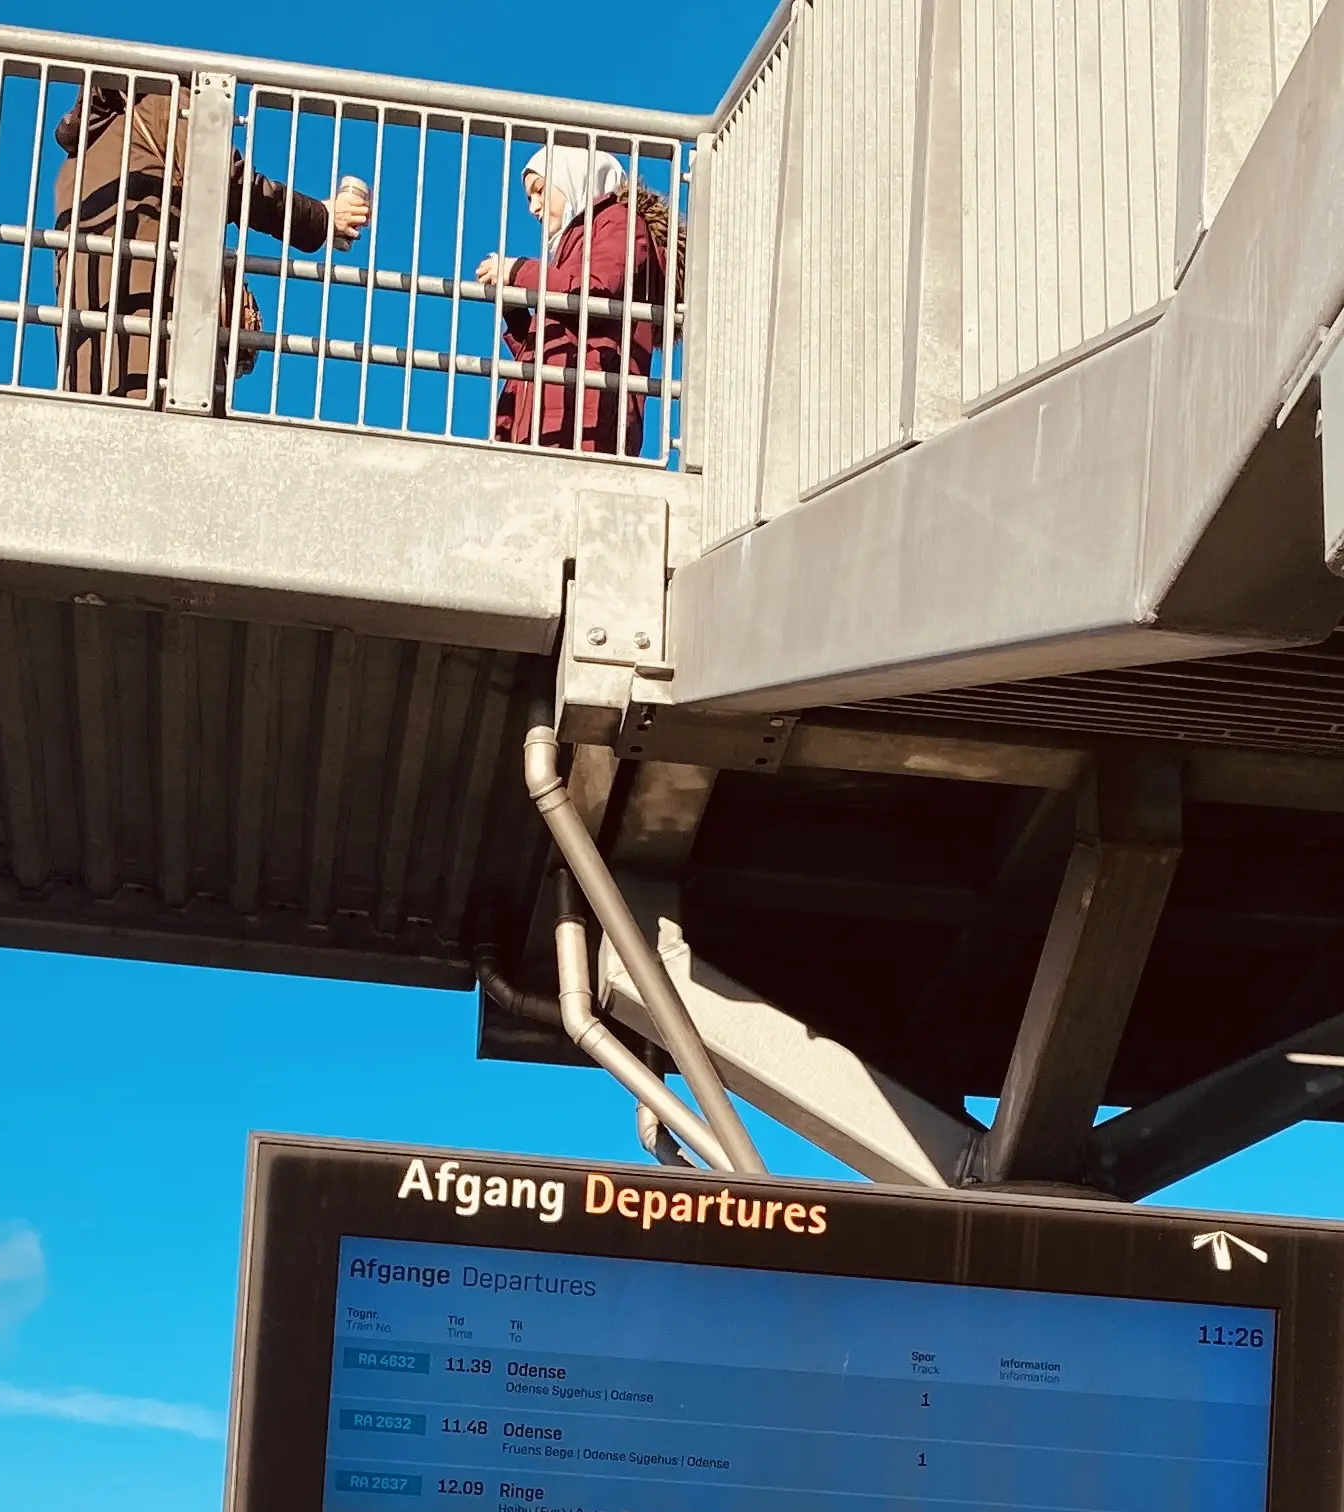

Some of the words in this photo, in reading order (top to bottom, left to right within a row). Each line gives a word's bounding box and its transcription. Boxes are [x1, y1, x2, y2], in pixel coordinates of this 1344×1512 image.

[397, 1159, 564, 1222] Afgang
[585, 1174, 826, 1234] Departures
[349, 1255, 450, 1288] Afgange
[462, 1266, 597, 1296] Departures
[345, 1320, 373, 1331] Train
[447, 1314, 464, 1326] Tid
[509, 1319, 523, 1330] Til
[447, 1327, 472, 1339] Time
[508, 1332, 522, 1343] To
[1197, 1324, 1264, 1349] 11:26
[358, 1353, 377, 1365] RA
[379, 1354, 415, 1368] 4632
[911, 1351, 936, 1363] Spor
[1000, 1357, 1060, 1371] Information
[444, 1356, 492, 1375] 11.39
[506, 1361, 566, 1380] Odense
[910, 1363, 940, 1375] Track
[999, 1370, 1060, 1384] Information
[505, 1382, 549, 1395] Odense
[551, 1385, 601, 1399] Sygehus
[610, 1389, 653, 1403] Odense
[919, 1392, 931, 1407] 1
[354, 1413, 373, 1427] RA
[375, 1415, 412, 1429] 2632
[440, 1417, 488, 1435] 11.48
[502, 1422, 562, 1441] Odense
[501, 1443, 541, 1456] Fruens
[582, 1448, 625, 1461] Odense
[628, 1451, 678, 1465] Sygehus
[687, 1456, 730, 1469] Odense
[917, 1452, 928, 1467] 1
[350, 1475, 368, 1487] RA
[371, 1477, 407, 1490] 2637
[436, 1478, 484, 1496] 12.09
[498, 1483, 544, 1502] Ringe
